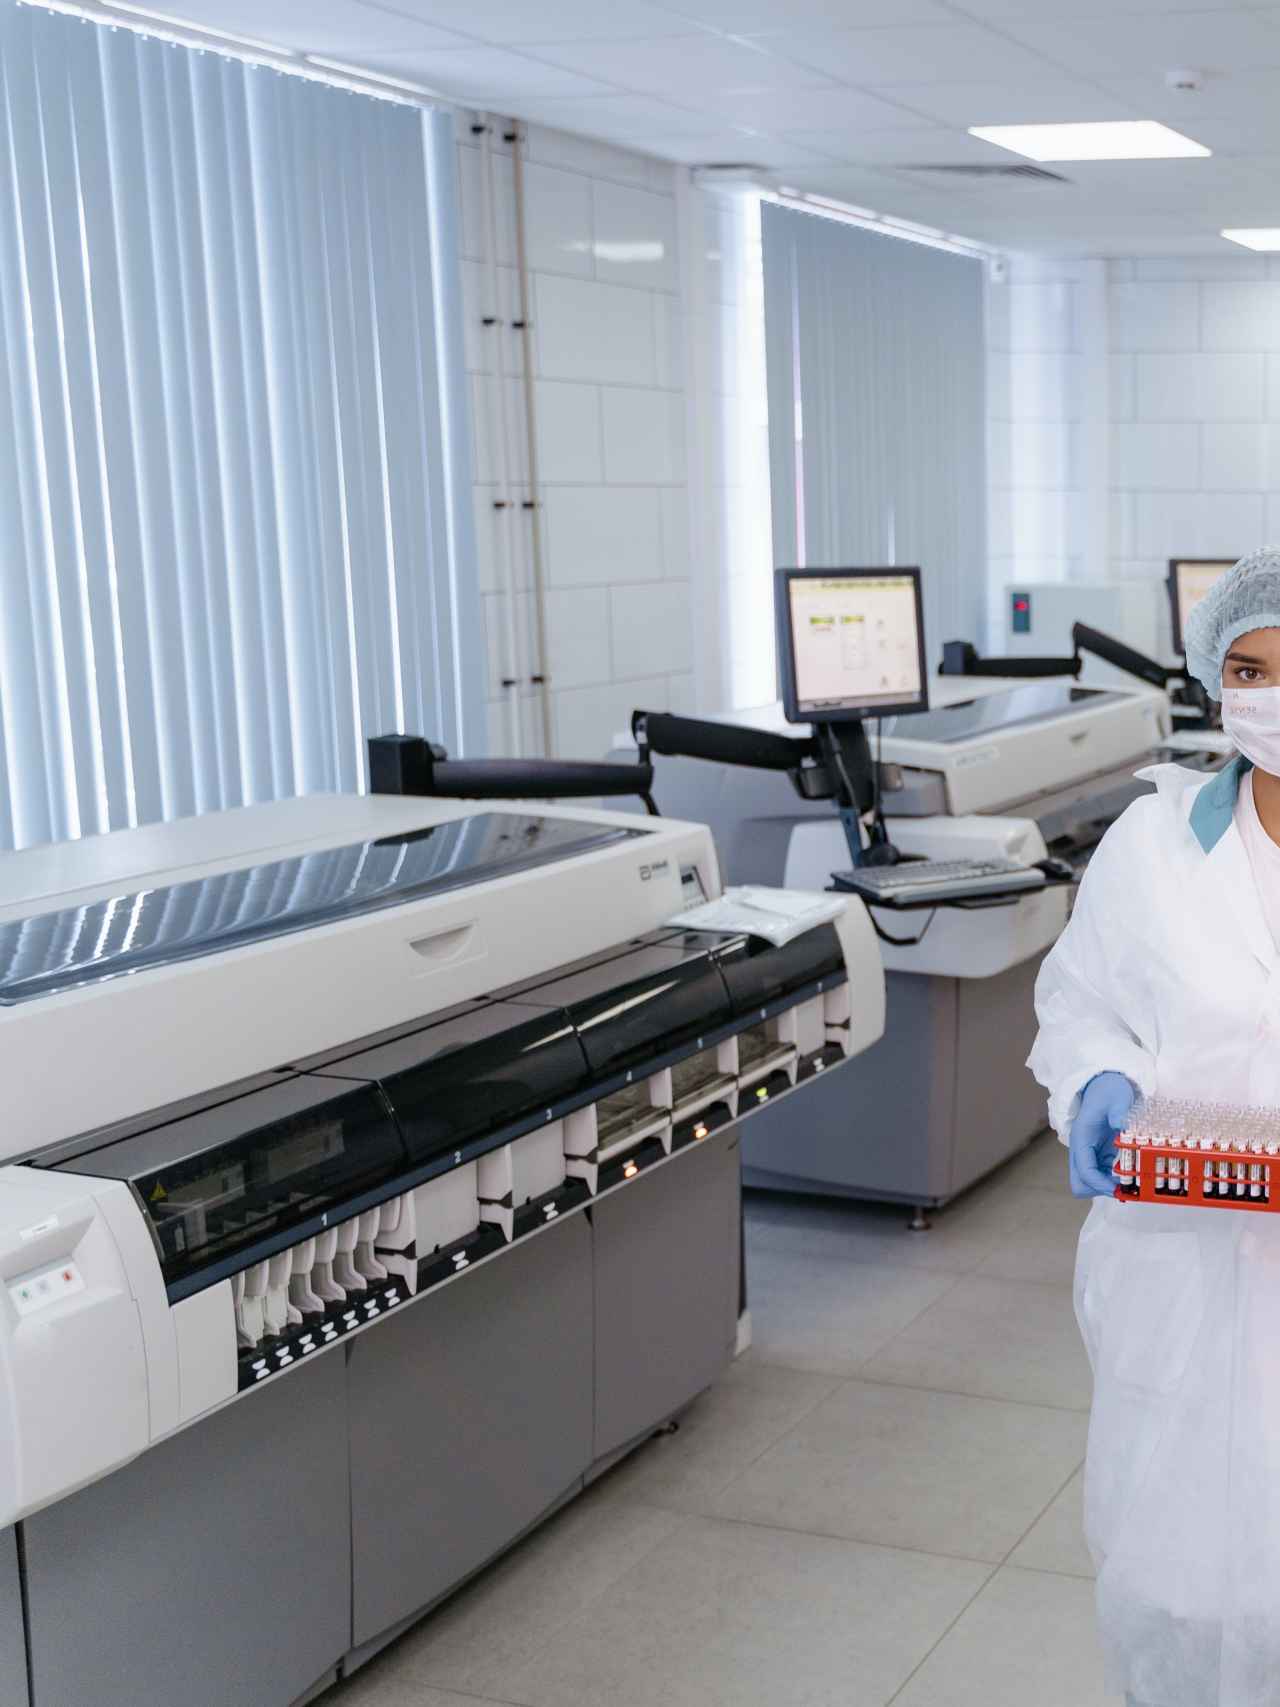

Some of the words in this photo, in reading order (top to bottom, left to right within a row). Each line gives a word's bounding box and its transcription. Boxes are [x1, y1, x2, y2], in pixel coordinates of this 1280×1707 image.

[545, 1108, 552, 1120] 3
[454, 1150, 462, 1163] 2
[321, 1212, 328, 1226] 1
